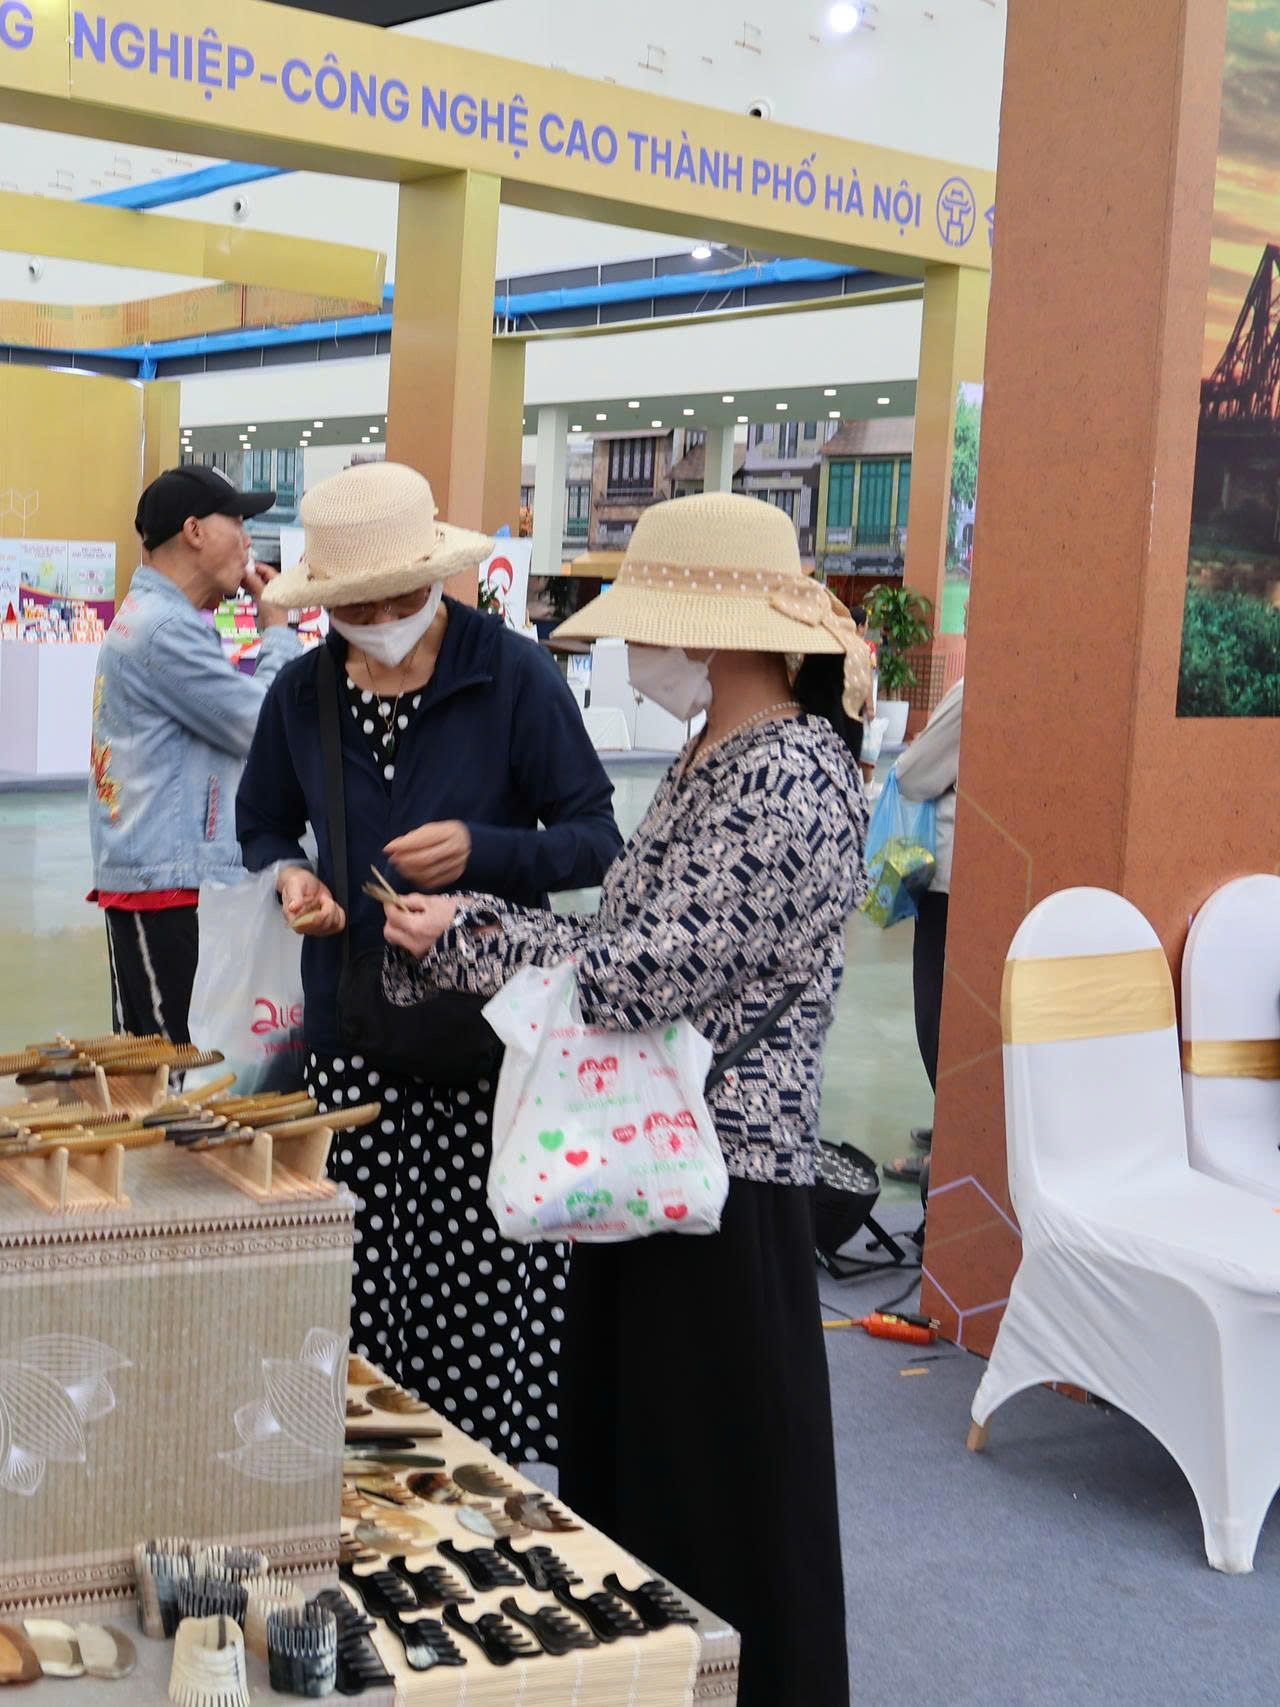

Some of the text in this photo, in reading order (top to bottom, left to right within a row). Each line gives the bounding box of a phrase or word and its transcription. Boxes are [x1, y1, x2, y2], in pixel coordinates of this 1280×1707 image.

[421, 85, 529, 159] NGHỆ
[539, 113, 618, 165] CAO
[627, 131, 744, 193] THÀNH
[751, 152, 817, 207] PHỐ
[823, 168, 865, 216] HÀ
[872, 179, 921, 236] NỘI
